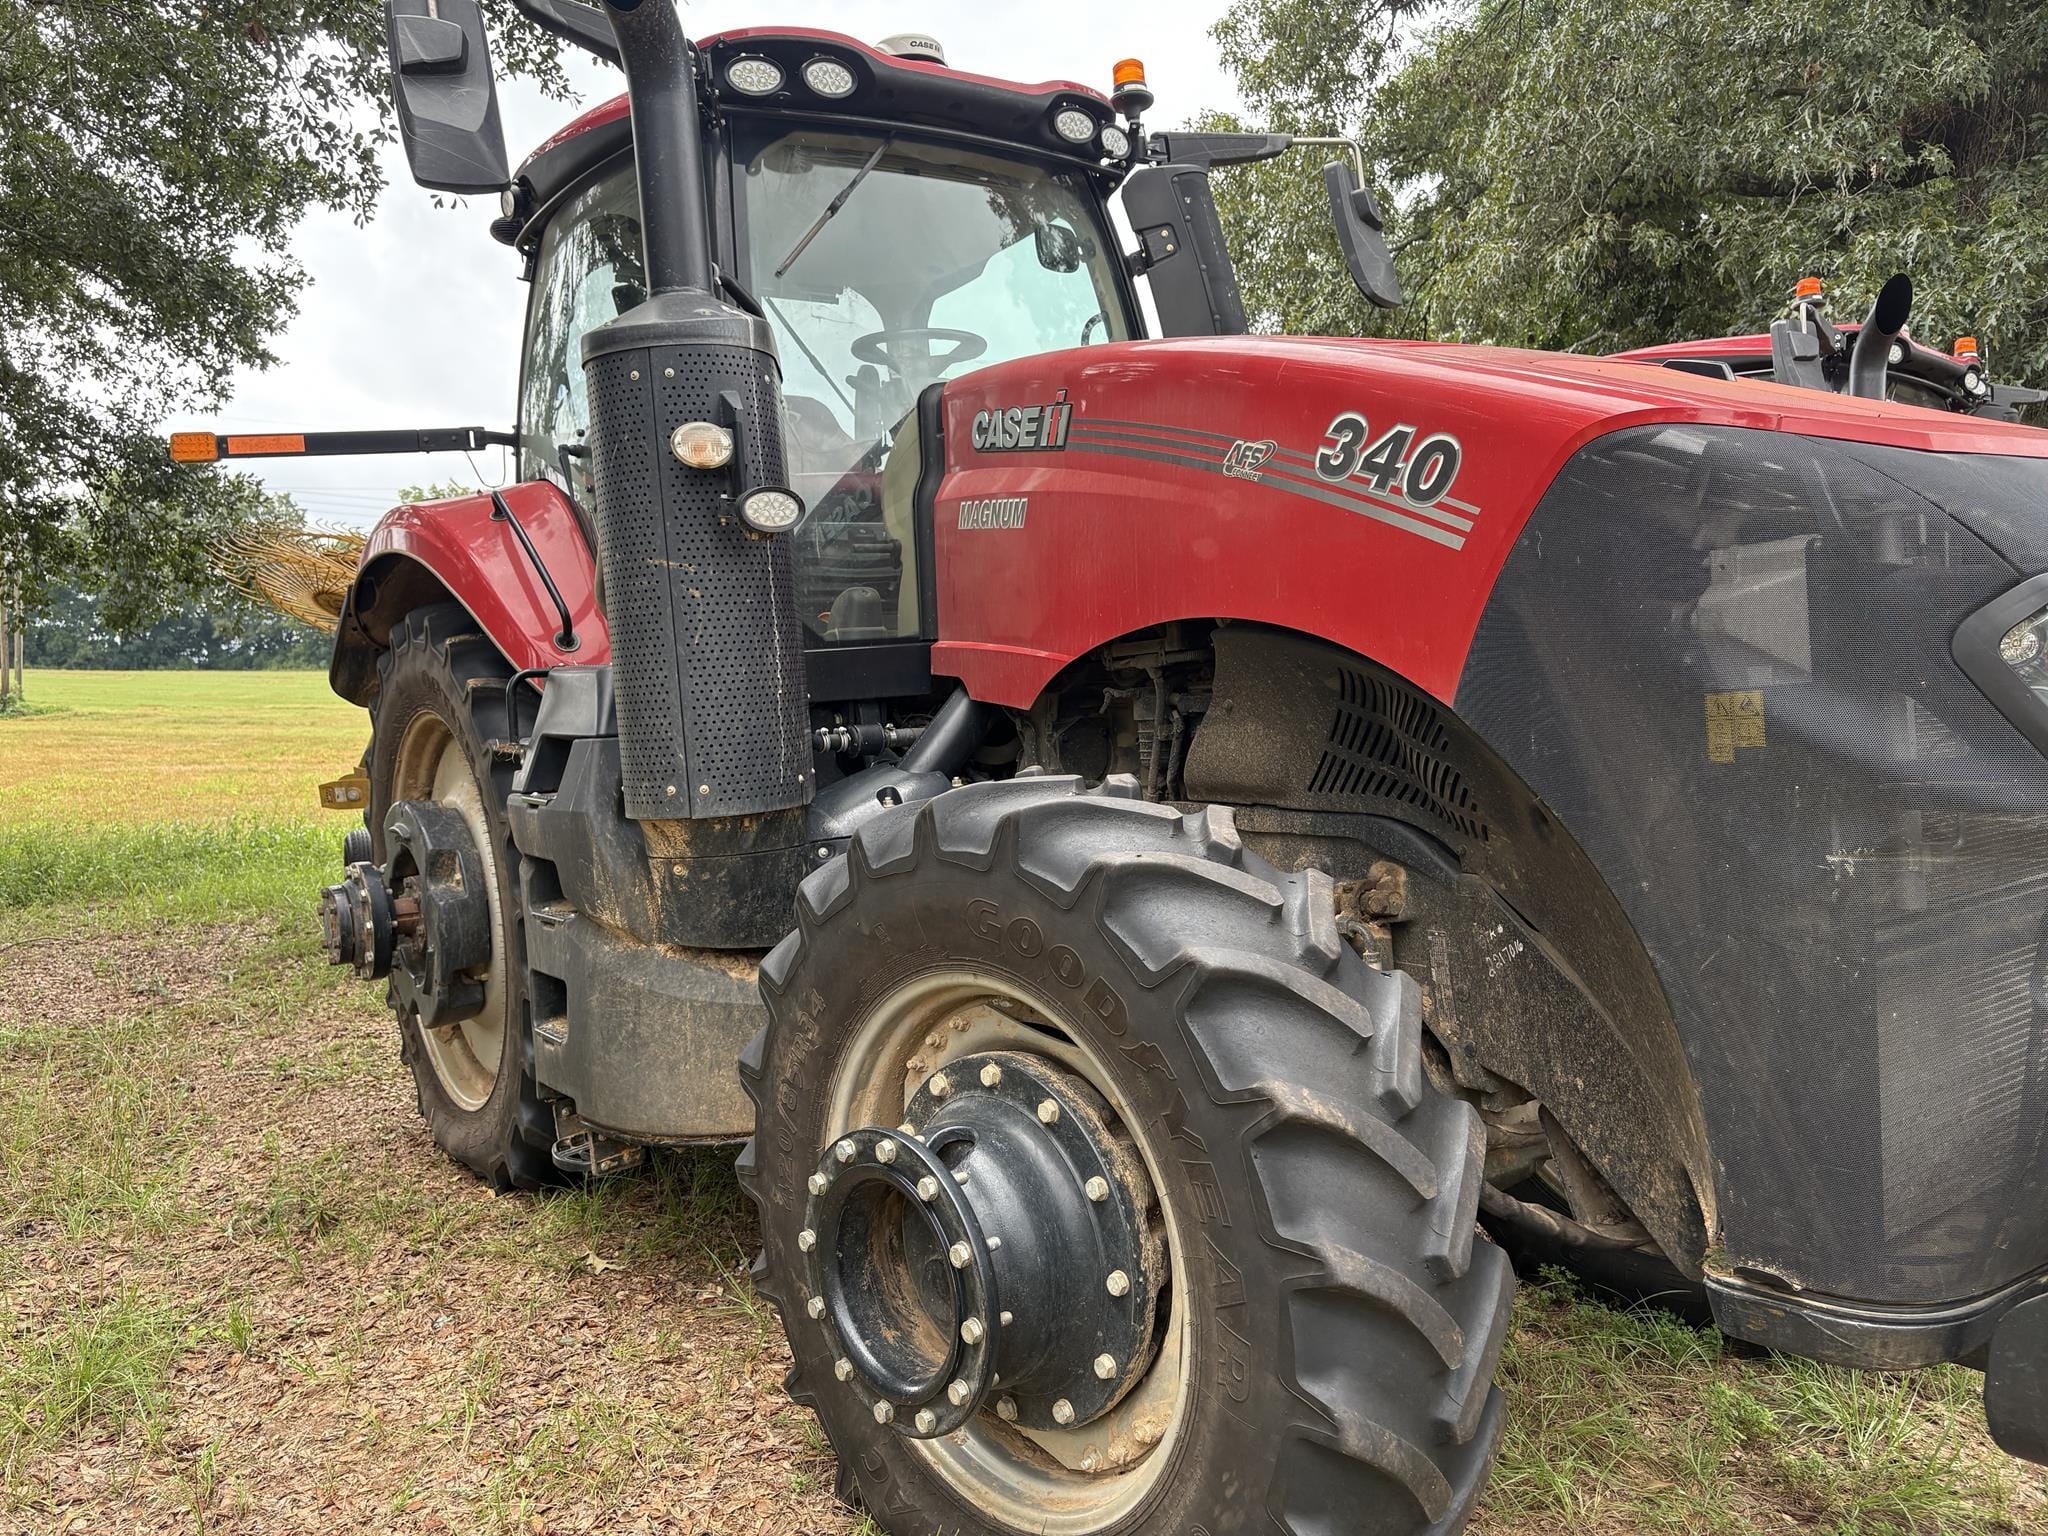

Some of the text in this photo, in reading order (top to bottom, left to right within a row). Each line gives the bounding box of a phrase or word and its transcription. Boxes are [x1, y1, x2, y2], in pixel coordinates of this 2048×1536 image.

[910, 40, 933, 50] CASE
[971, 405, 1043, 451] CASE
[1223, 440, 1268, 469] AFS
[1315, 411, 1461, 507] 340
[958, 497, 1028, 530] MAGNUM
